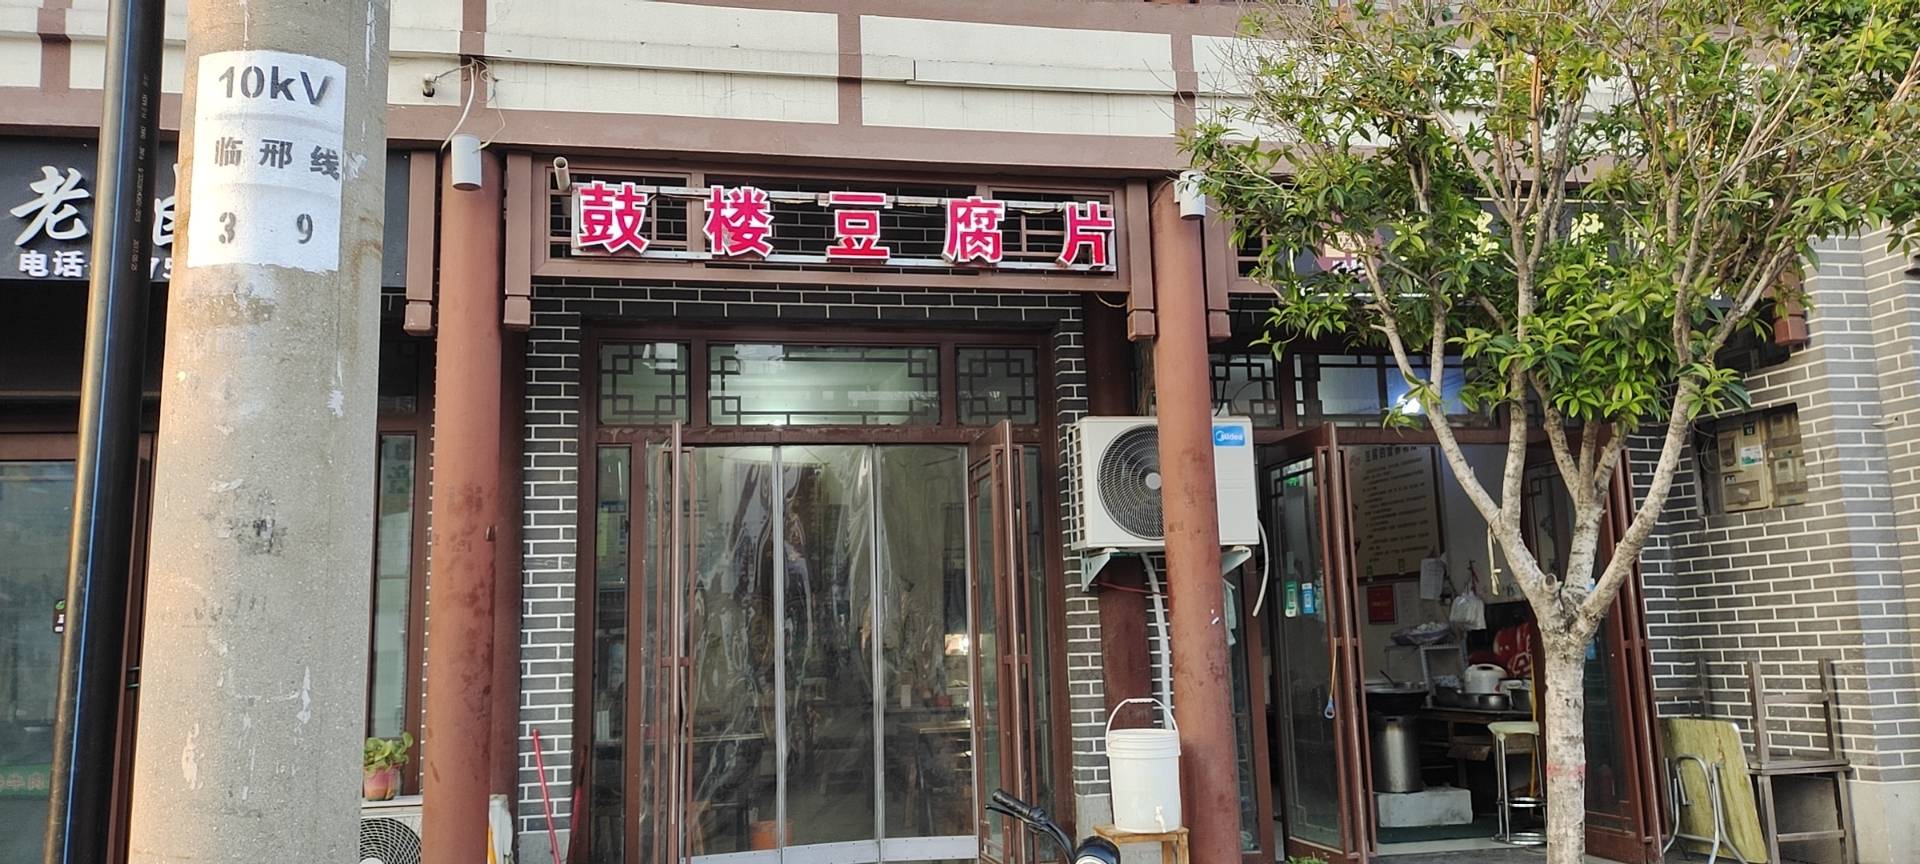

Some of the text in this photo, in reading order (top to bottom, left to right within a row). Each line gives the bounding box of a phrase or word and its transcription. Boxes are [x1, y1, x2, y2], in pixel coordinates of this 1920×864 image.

[218, 65, 334, 106] 10kV
[214, 136, 340, 181] 临邢线
[218, 211, 314, 245] 3 9
[577, 180, 1115, 268] 鼓楼豆腐片
